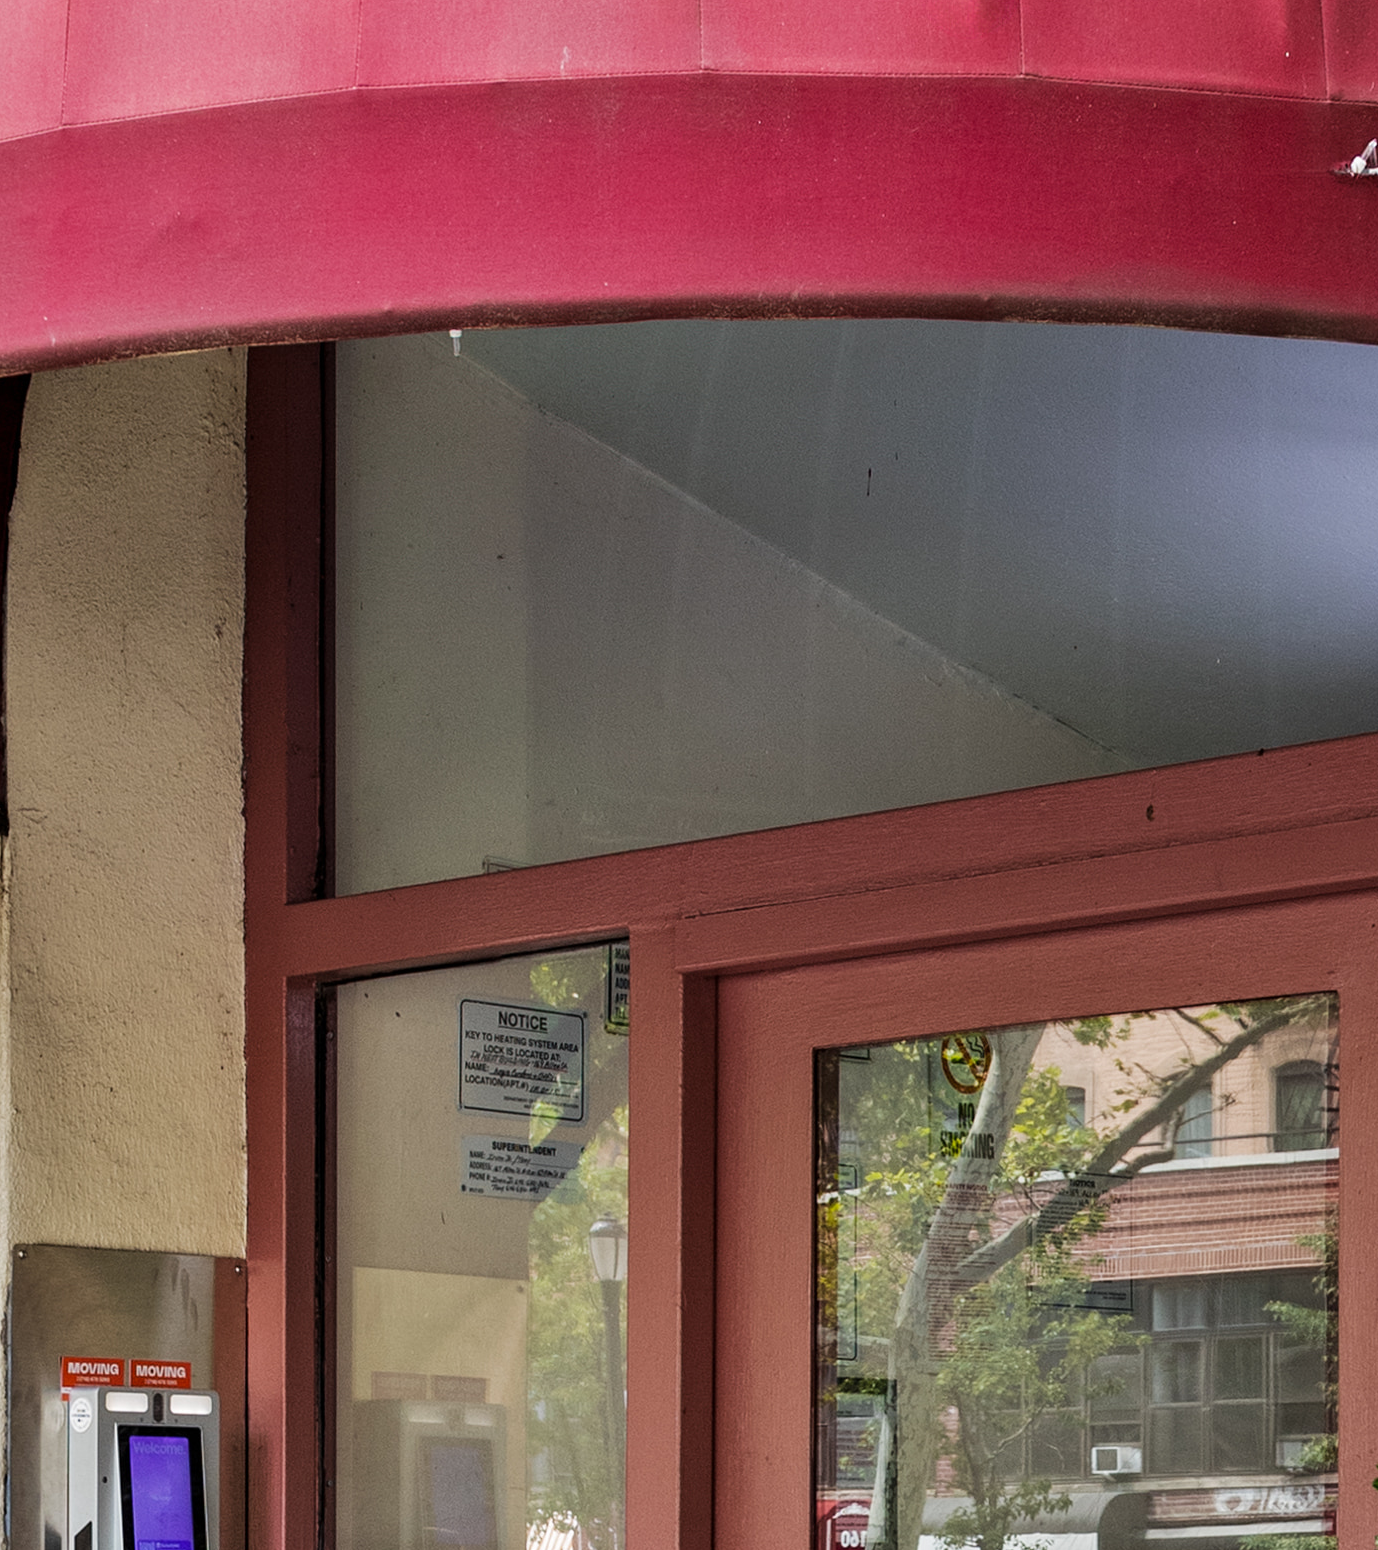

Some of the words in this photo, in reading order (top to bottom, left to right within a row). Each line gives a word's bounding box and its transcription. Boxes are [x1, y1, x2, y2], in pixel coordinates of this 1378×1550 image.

[498, 1011, 547, 1030] NOTICE
[465, 1030, 481, 1040] KEY
[482, 1032, 492, 1041] TO
[494, 1033, 527, 1045] HEATING
[529, 1038, 559, 1050] SYSTEM
[559, 1042, 579, 1053] AREA
[484, 1044, 504, 1054] LOCK
[505, 1046, 514, 1056] IS
[515, 1047, 550, 1060] LOCATED
[465, 1061, 490, 1072] NAME:
[958, 1102, 974, 1129] NO
[492, 1140, 557, 1157] SUPERINTENDENT
[67, 1362, 119, 1376] MOVING
[135, 1364, 186, 1378] MOVING
